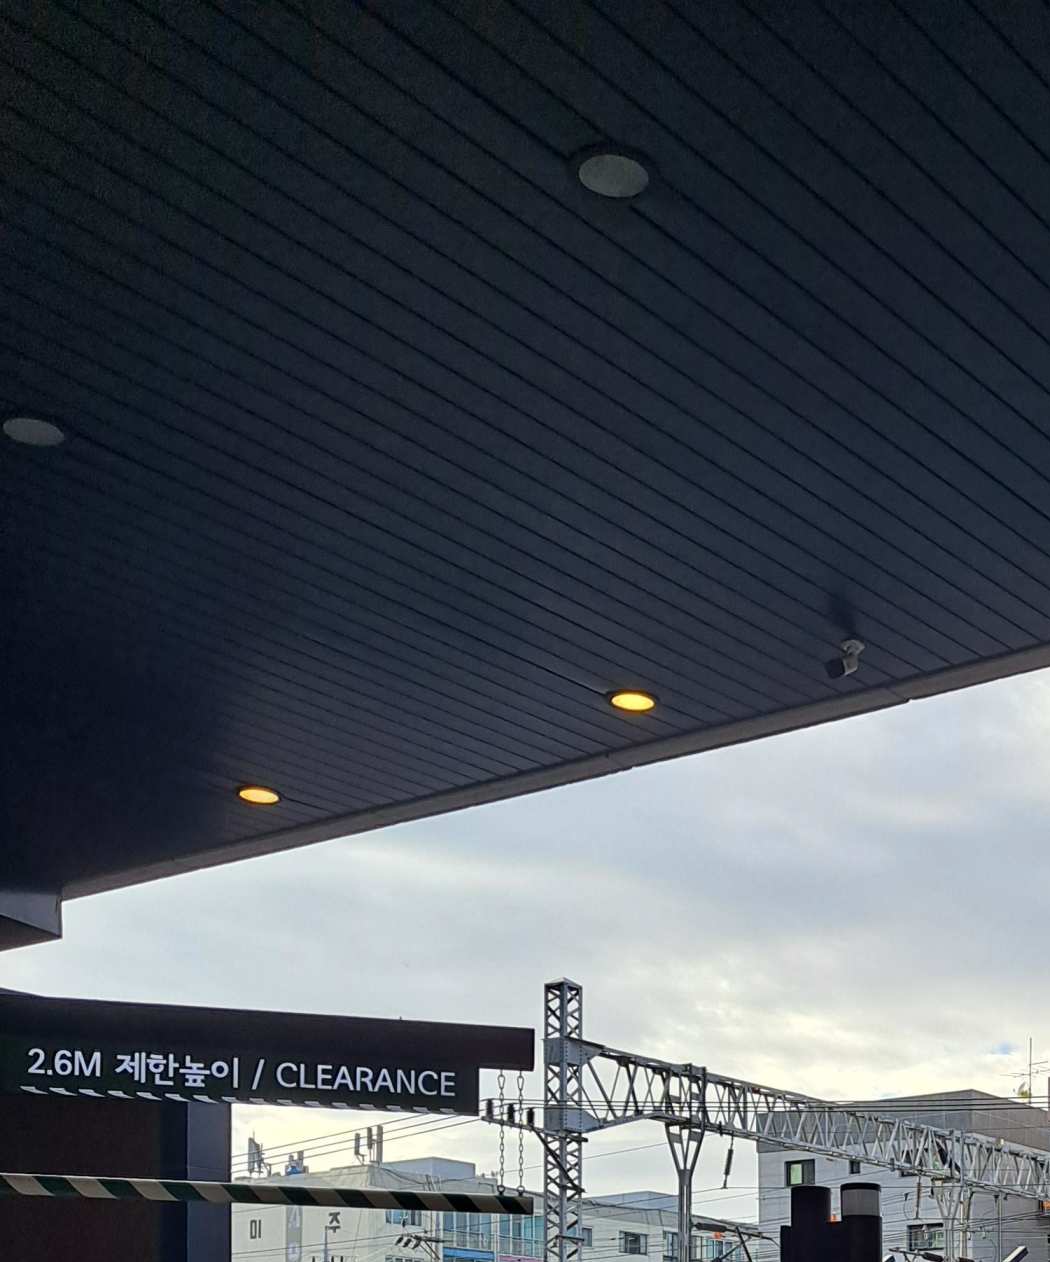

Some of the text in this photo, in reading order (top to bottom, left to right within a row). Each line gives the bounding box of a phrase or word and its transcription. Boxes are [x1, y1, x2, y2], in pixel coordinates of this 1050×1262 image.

[27, 1048, 457, 1097] 2.6M 제한높이 / CLEARANCE
